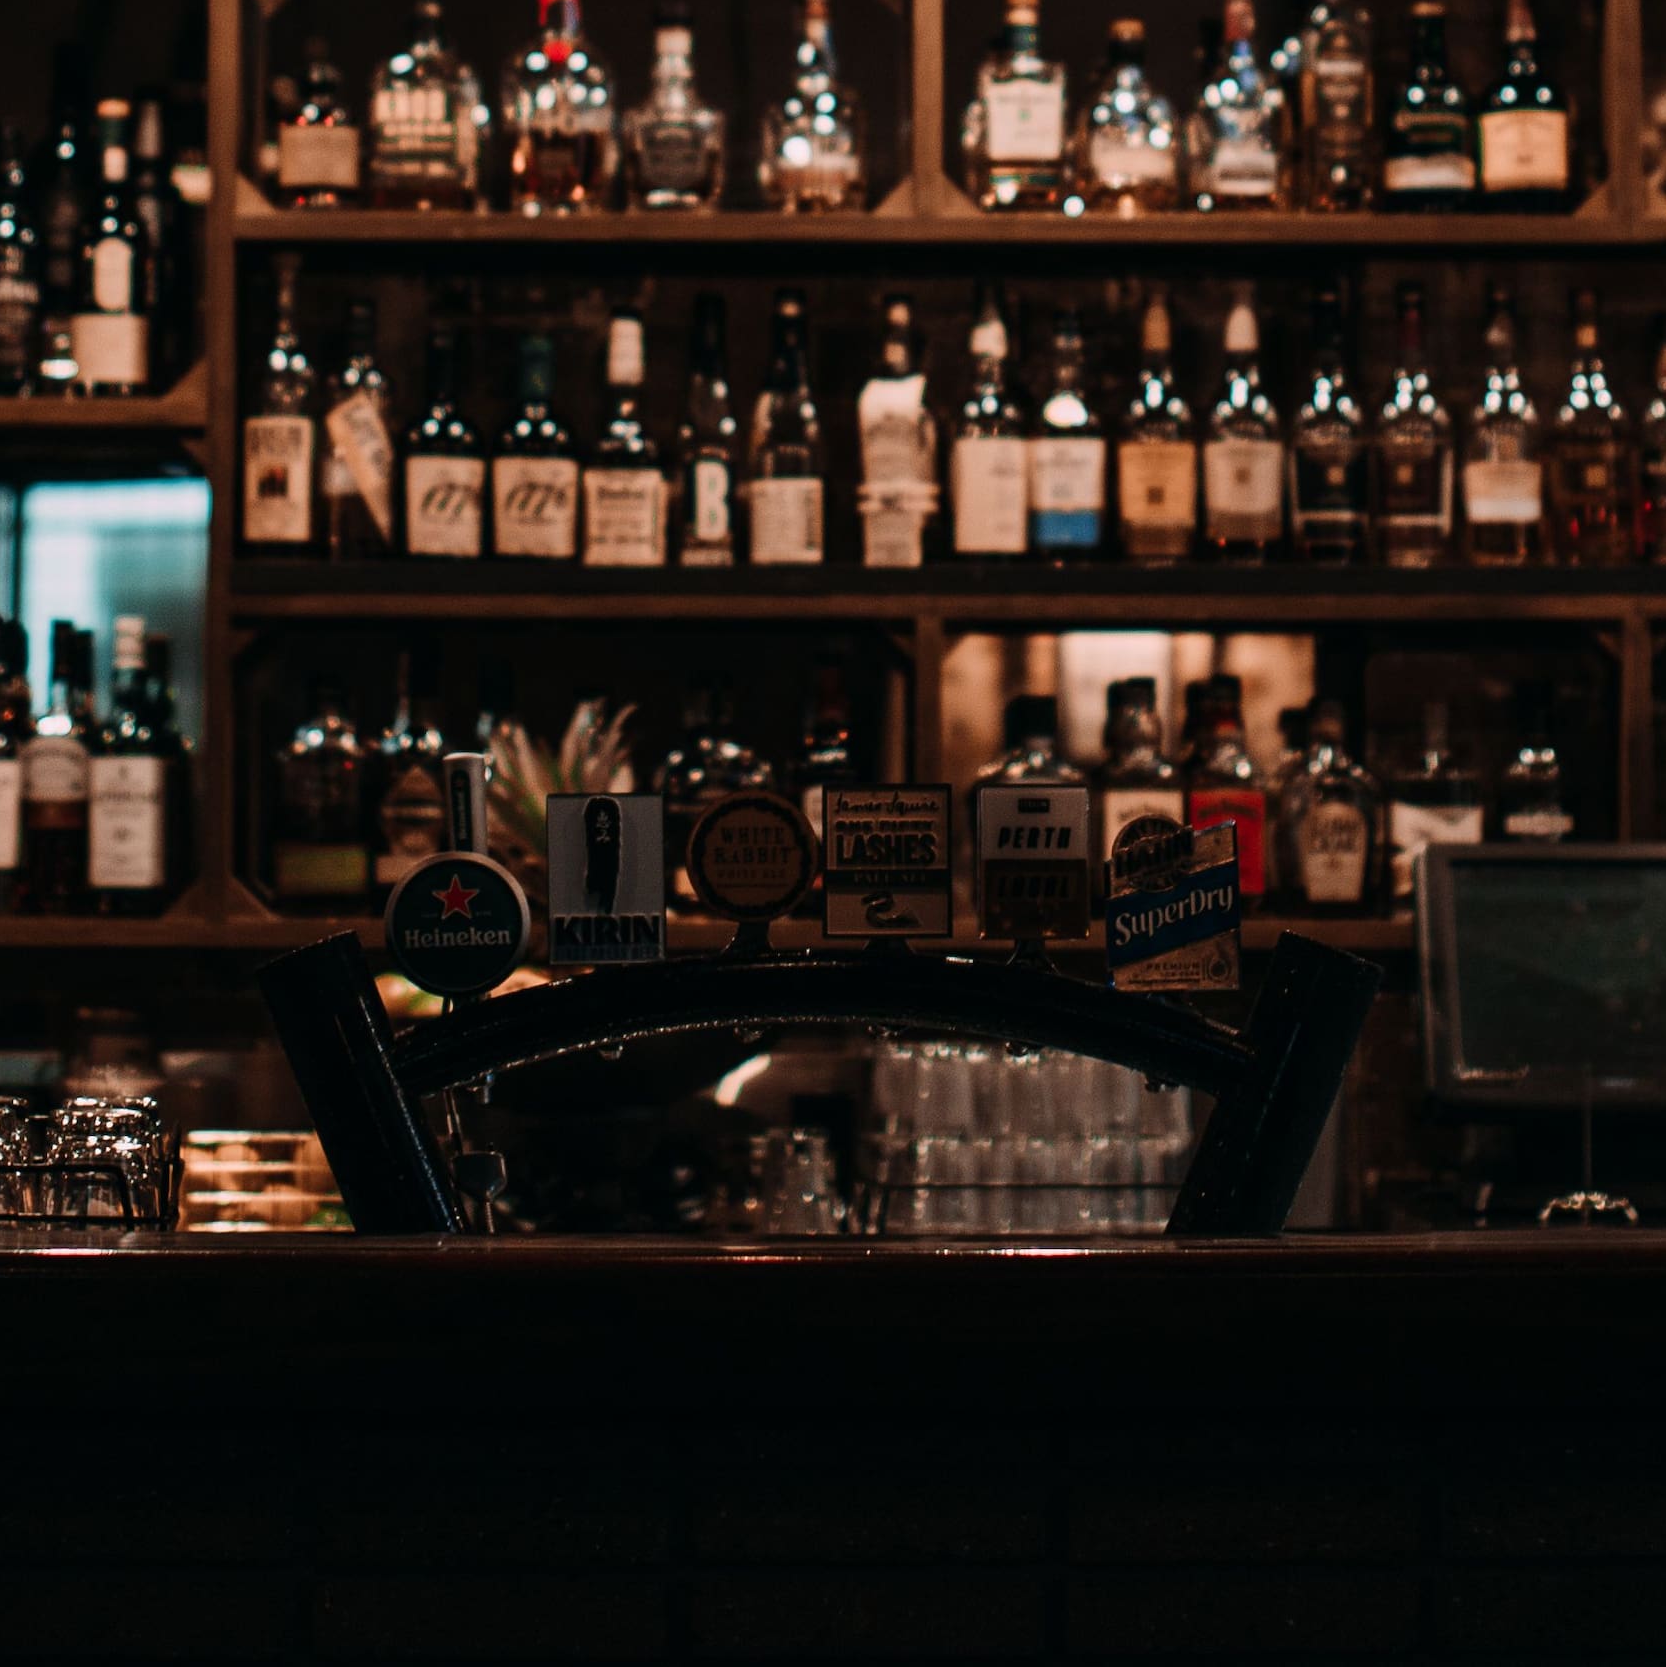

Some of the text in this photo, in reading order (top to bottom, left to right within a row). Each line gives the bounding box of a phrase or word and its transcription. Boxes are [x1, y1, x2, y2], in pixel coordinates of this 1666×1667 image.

[720, 826, 786, 845] WHITE
[997, 826, 1072, 849] PERTH
[715, 846, 794, 864] RABBIT
[836, 833, 936, 866] LASHES
[1113, 885, 1235, 949] SuperDry
[404, 926, 512, 950] Heineken
[554, 916, 660, 944] KIRIN
